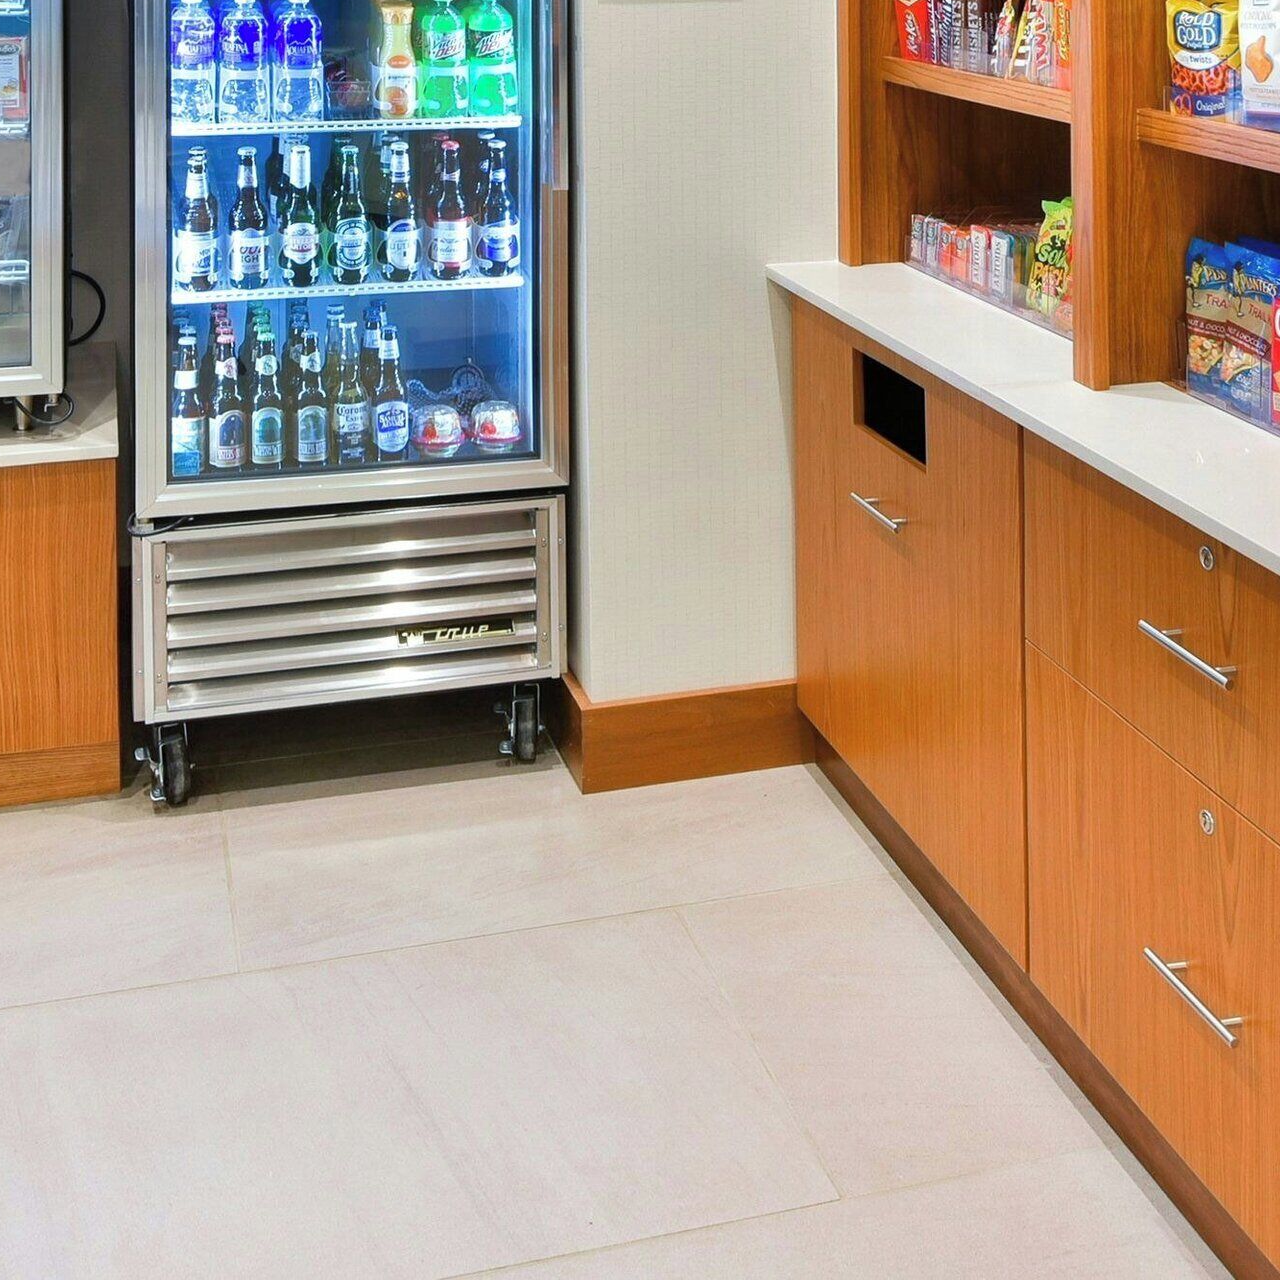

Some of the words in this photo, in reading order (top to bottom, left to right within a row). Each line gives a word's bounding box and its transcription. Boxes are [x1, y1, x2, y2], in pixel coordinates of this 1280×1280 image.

[1178, 11, 1215, 27] ROLD
[1176, 26, 1217, 46] GOLD
[1189, 55, 1213, 64] twists
[1195, 98, 1226, 115] Original
[972, 235, 982, 282] ALTOIDS
[993, 240, 1002, 289] ALTOIDS
[1242, 274, 1278, 298] PLANTERS
